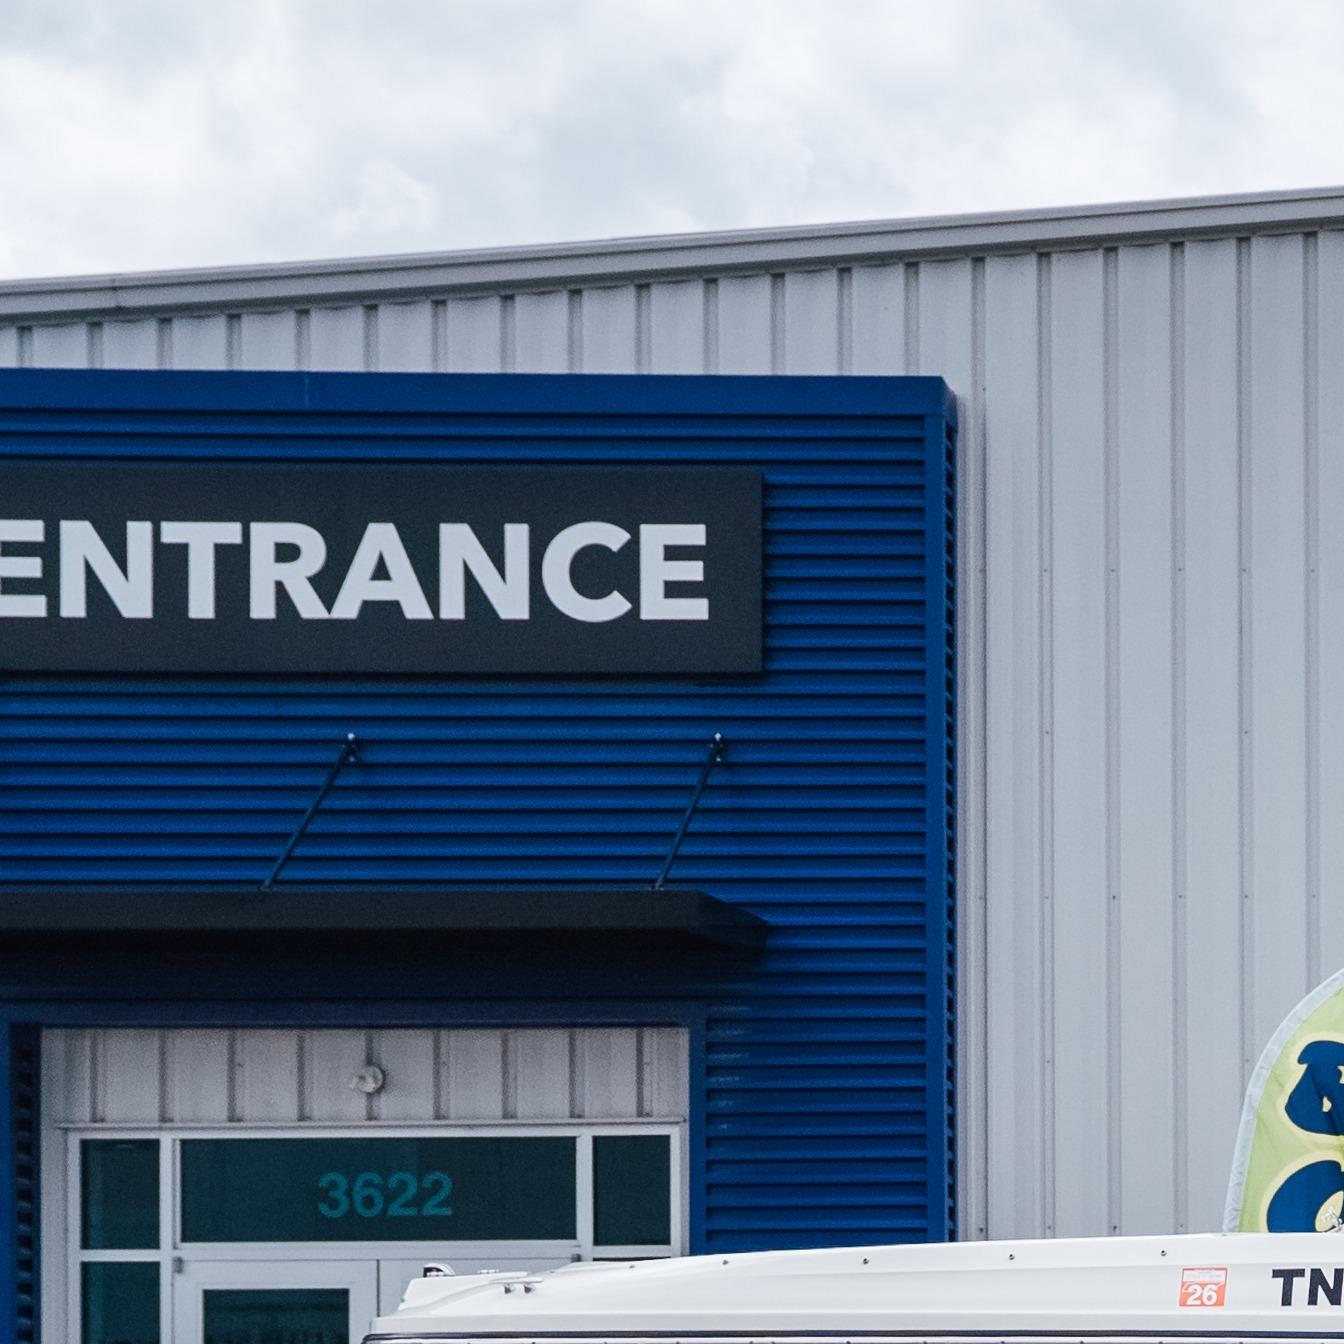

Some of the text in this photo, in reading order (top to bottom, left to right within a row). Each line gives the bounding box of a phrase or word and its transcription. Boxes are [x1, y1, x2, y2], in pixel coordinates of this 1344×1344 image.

[0, 518, 710, 624] ENTRANCE
[318, 1171, 453, 1218] 3622
[1185, 1283, 1217, 1305] 26
[1272, 1268, 1344, 1306] TN
